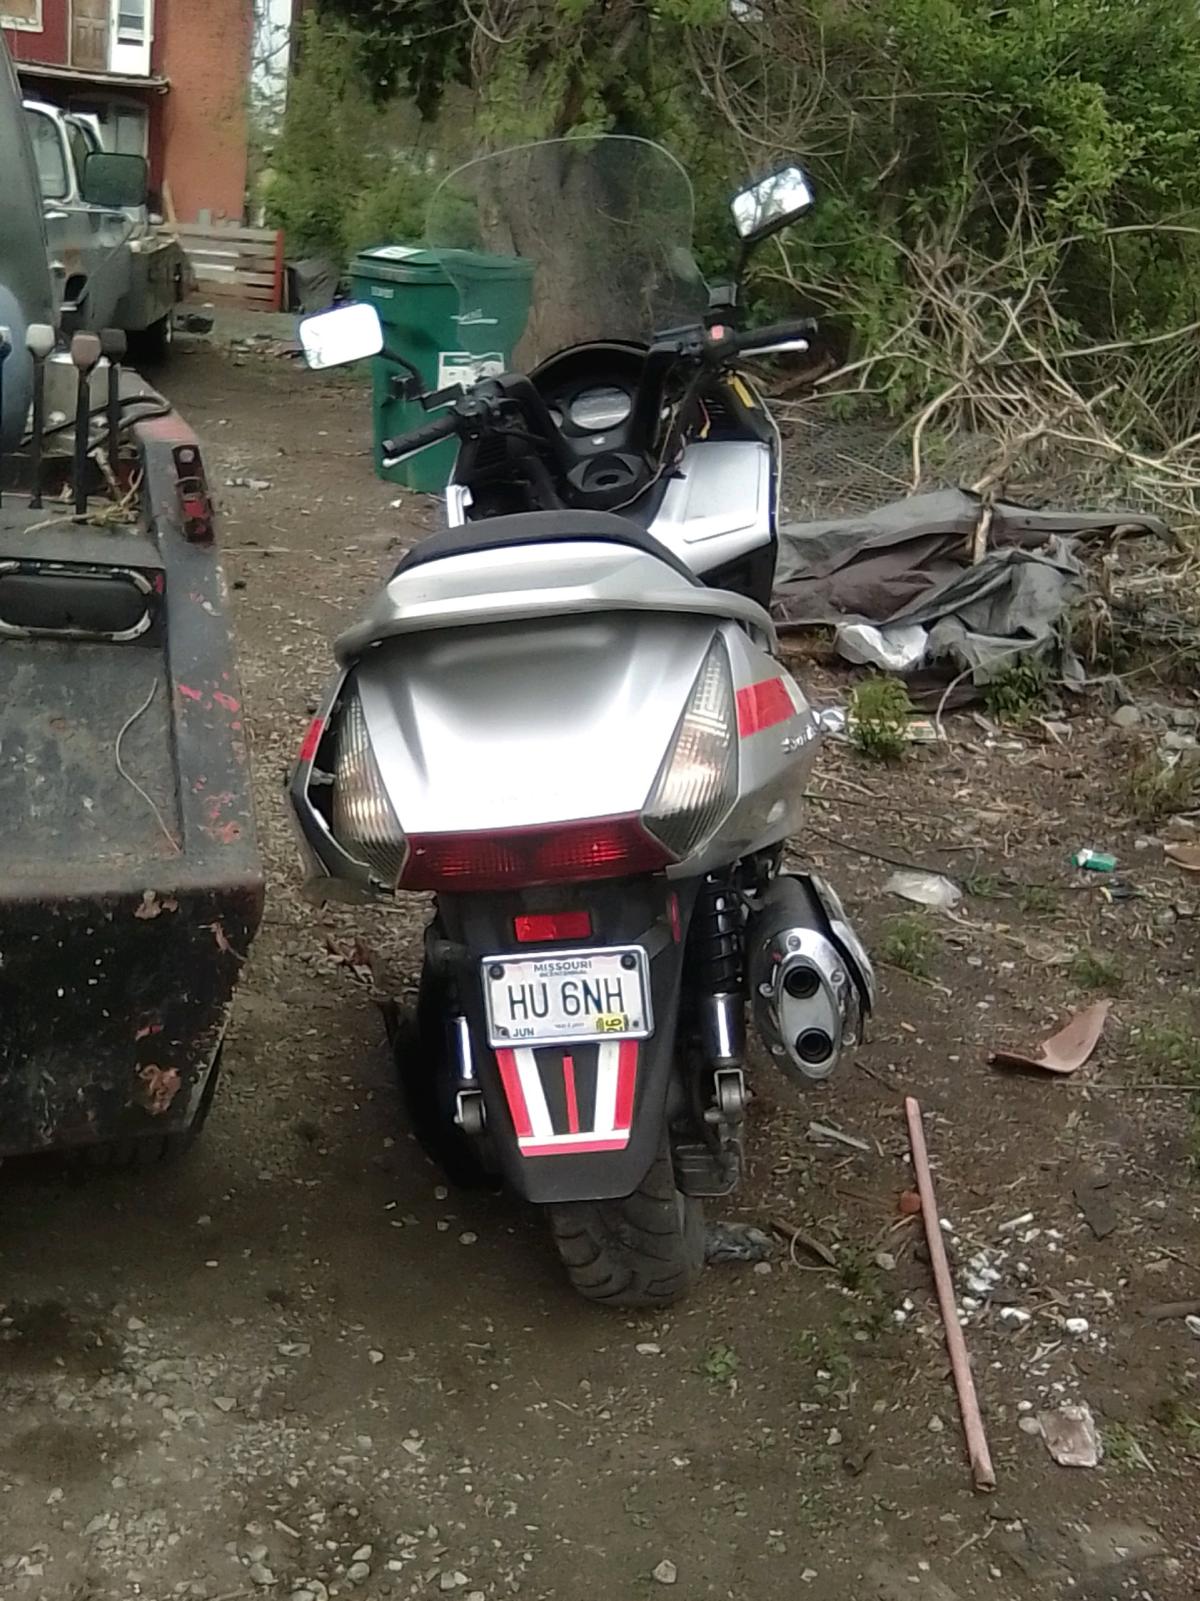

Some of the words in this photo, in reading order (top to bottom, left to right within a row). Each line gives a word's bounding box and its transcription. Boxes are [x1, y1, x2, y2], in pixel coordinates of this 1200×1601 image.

[533, 960, 593, 973] MISSOURI
[508, 982, 549, 1020] HU
[561, 977, 625, 1016] 6NH
[513, 1027, 535, 1038] JUN
